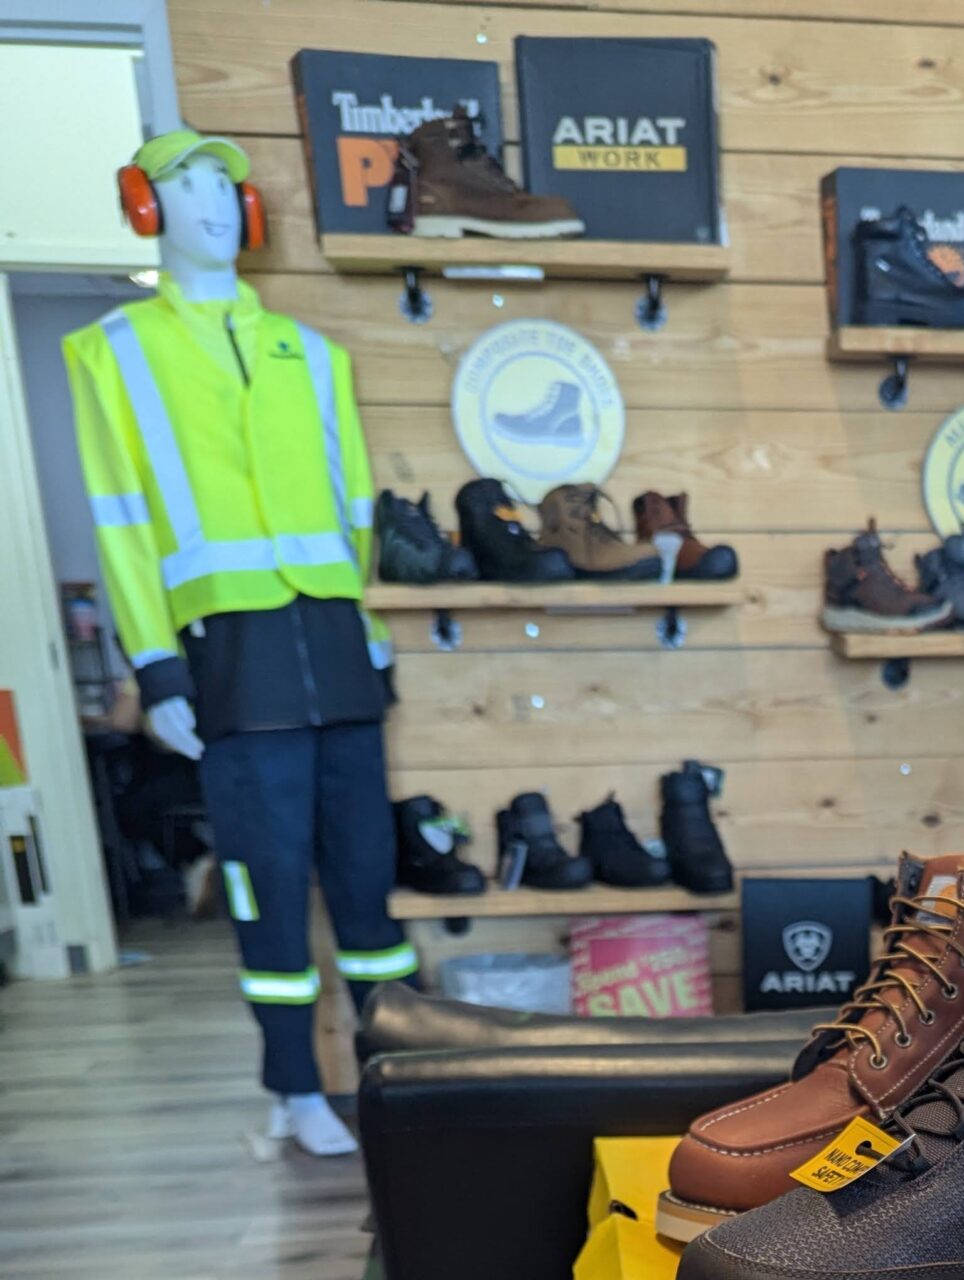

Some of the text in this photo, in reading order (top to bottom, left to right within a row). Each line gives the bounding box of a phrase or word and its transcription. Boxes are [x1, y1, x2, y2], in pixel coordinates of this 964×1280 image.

[553, 117, 686, 145] ARIAT
[578, 149, 663, 168] WORK
[588, 970, 699, 1018] SAVE
[760, 970, 856, 994] ARIAT
